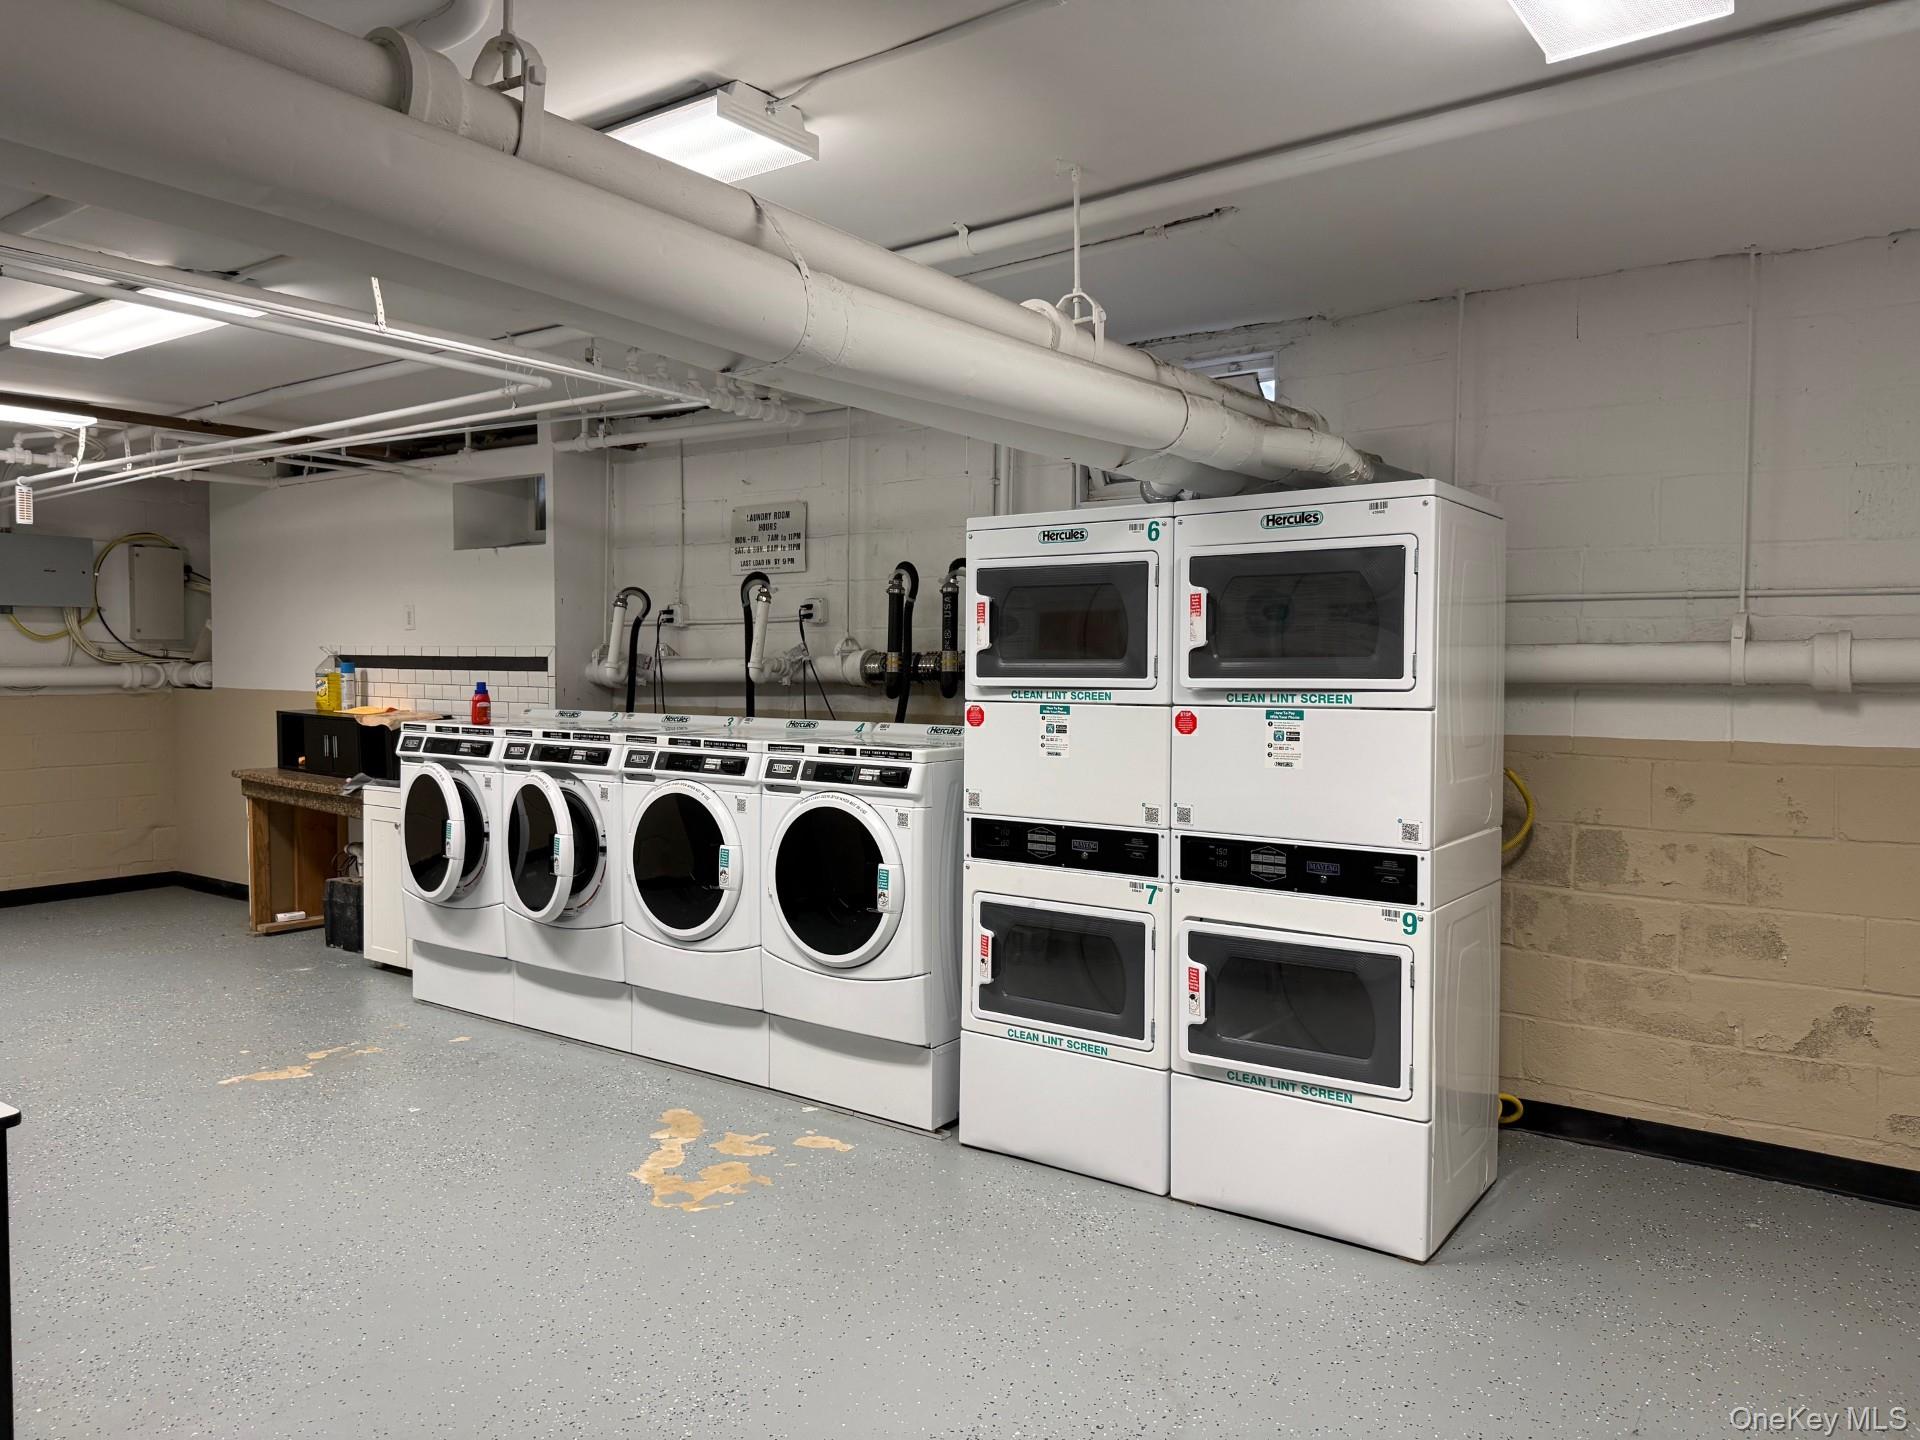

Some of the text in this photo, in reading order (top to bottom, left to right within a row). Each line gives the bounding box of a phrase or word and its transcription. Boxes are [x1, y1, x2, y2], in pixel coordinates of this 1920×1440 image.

[746, 511, 790, 522] LAUNDRY ROOM
[1266, 512, 1319, 526] Hercules
[758, 522, 777, 531] HOURS
[1148, 520, 1160, 542] 6
[1042, 530, 1084, 542] Hercules
[1011, 690, 1112, 700] CLEAN LINT SCREEN
[1226, 693, 1352, 704] CLEAN LINT SCREEN
[608, 712, 618, 721] 2
[727, 717, 734, 726] 3
[855, 723, 865, 733] 4
[930, 726, 962, 735] Hercules
[1146, 884, 1158, 905] 7
[1402, 912, 1418, 935] 9
[1007, 1028, 1108, 1056] CLEAN LINT SCREEN
[1226, 1070, 1353, 1104] CLEAN LINT SCREEN
